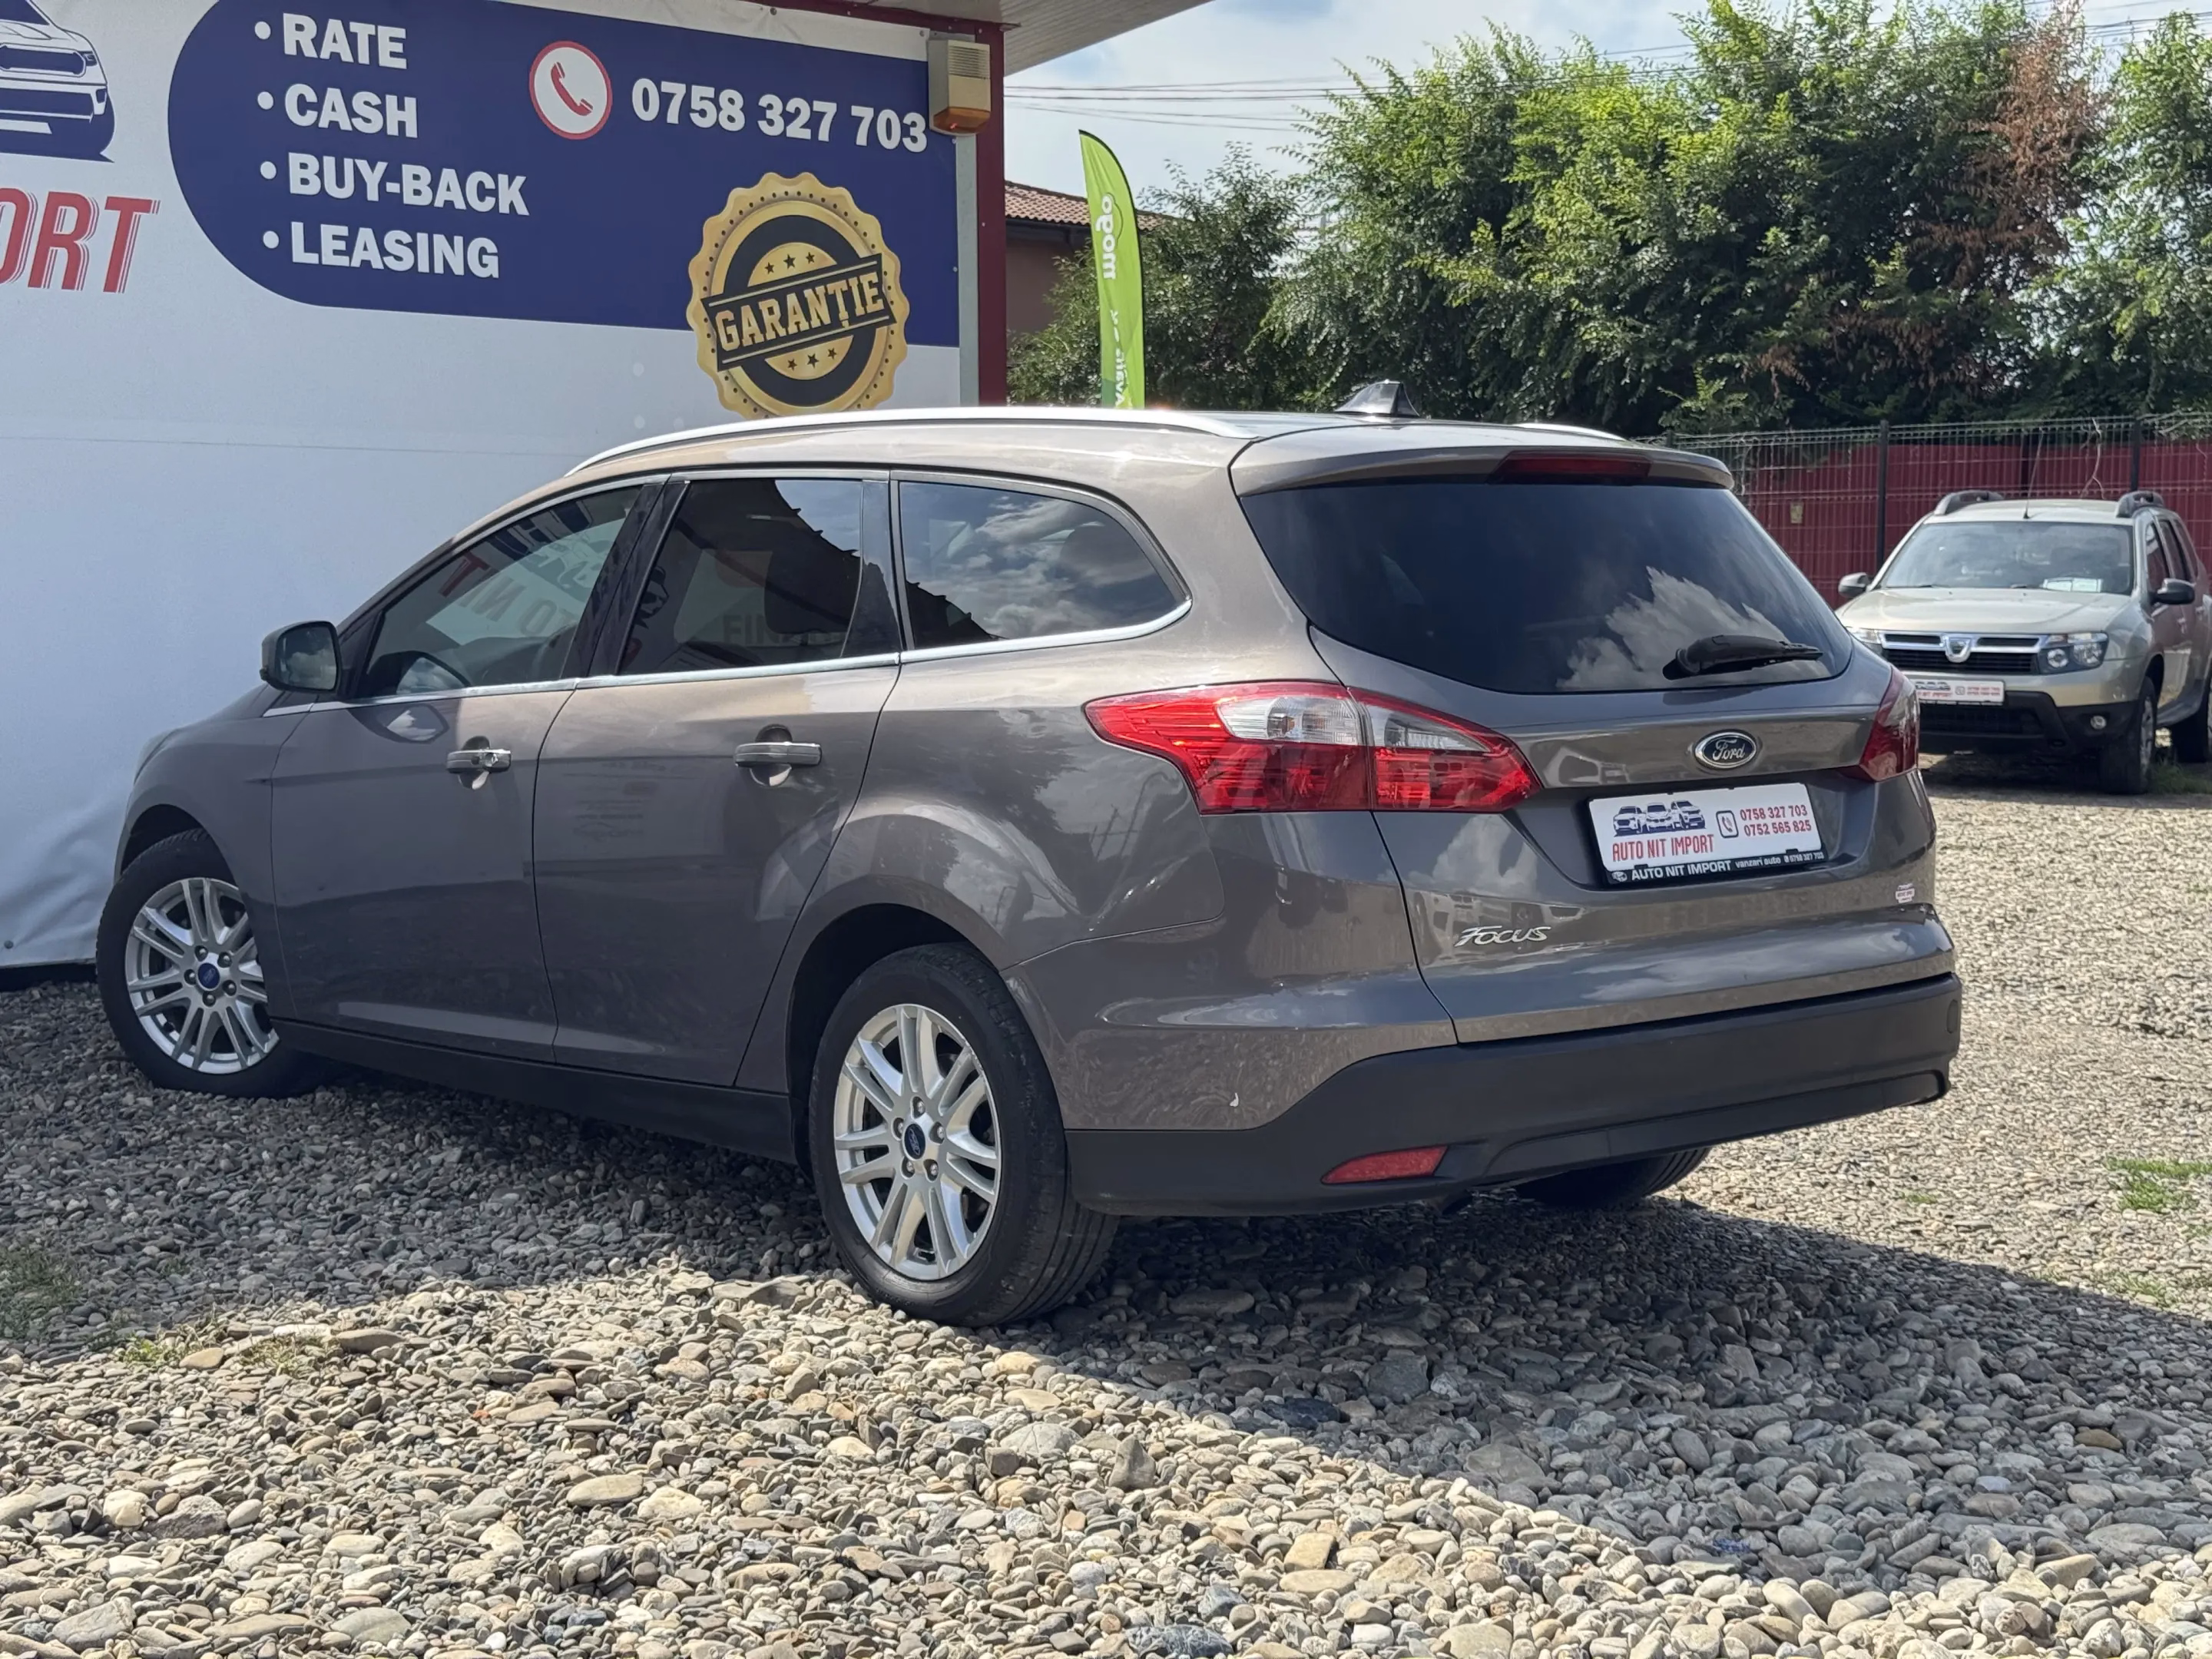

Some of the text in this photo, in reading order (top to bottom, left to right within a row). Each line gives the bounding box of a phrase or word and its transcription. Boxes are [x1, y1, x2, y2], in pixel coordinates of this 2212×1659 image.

[282, 12, 408, 69] RATE
[284, 83, 419, 139] CASH
[632, 78, 927, 153] 0758 327 703
[288, 152, 530, 216] BUY-BACK
[290, 221, 499, 279] LEASING
[1712, 739, 1746, 761] Ford
[1740, 804, 1808, 821] 0758 327 703
[1743, 820, 1812, 836] 0752 565 825
[1612, 834, 1714, 862] AUTO NIT IMPORT
[1631, 866, 1664, 881] AUTO
[1666, 865, 1685, 877] NIT
[1687, 860, 1732, 876] IMPORT
